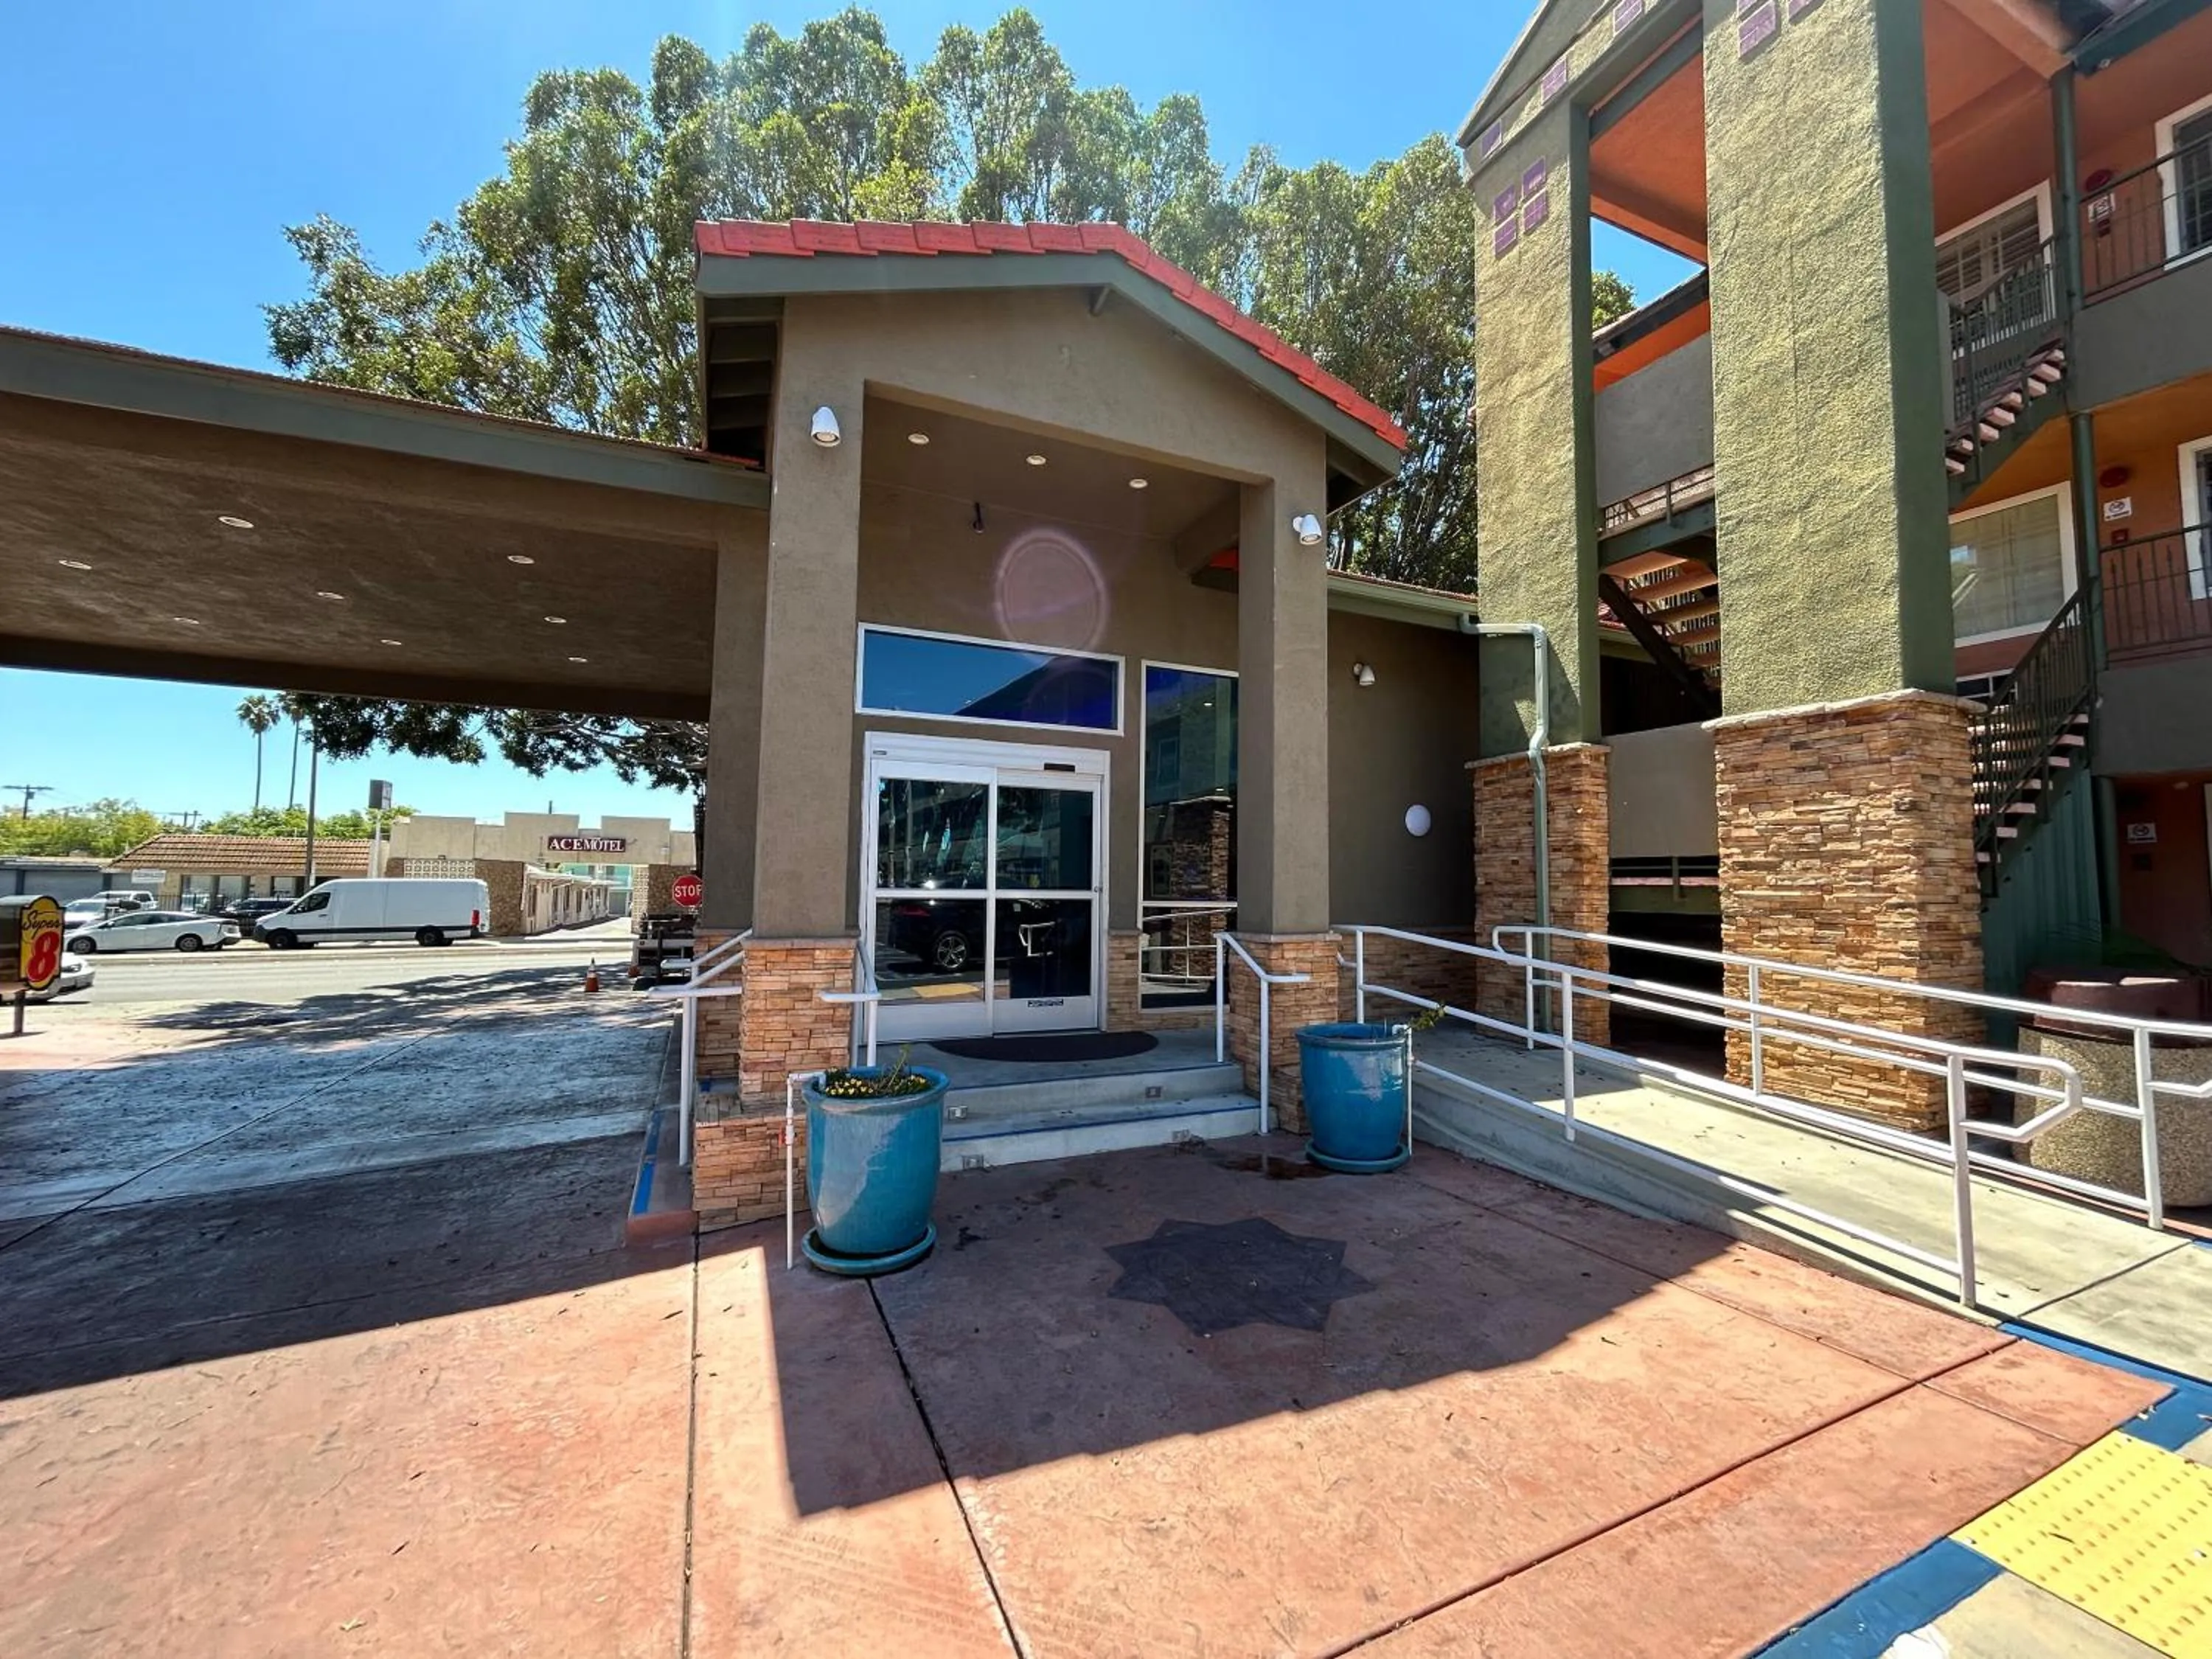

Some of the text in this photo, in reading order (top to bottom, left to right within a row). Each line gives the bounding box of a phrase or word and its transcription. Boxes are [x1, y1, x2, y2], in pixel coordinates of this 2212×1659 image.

[549, 838, 624, 852] ACE MOTEL
[675, 885, 702, 897] STOP
[22, 910, 60, 939] Super
[27, 931, 59, 982] 8
